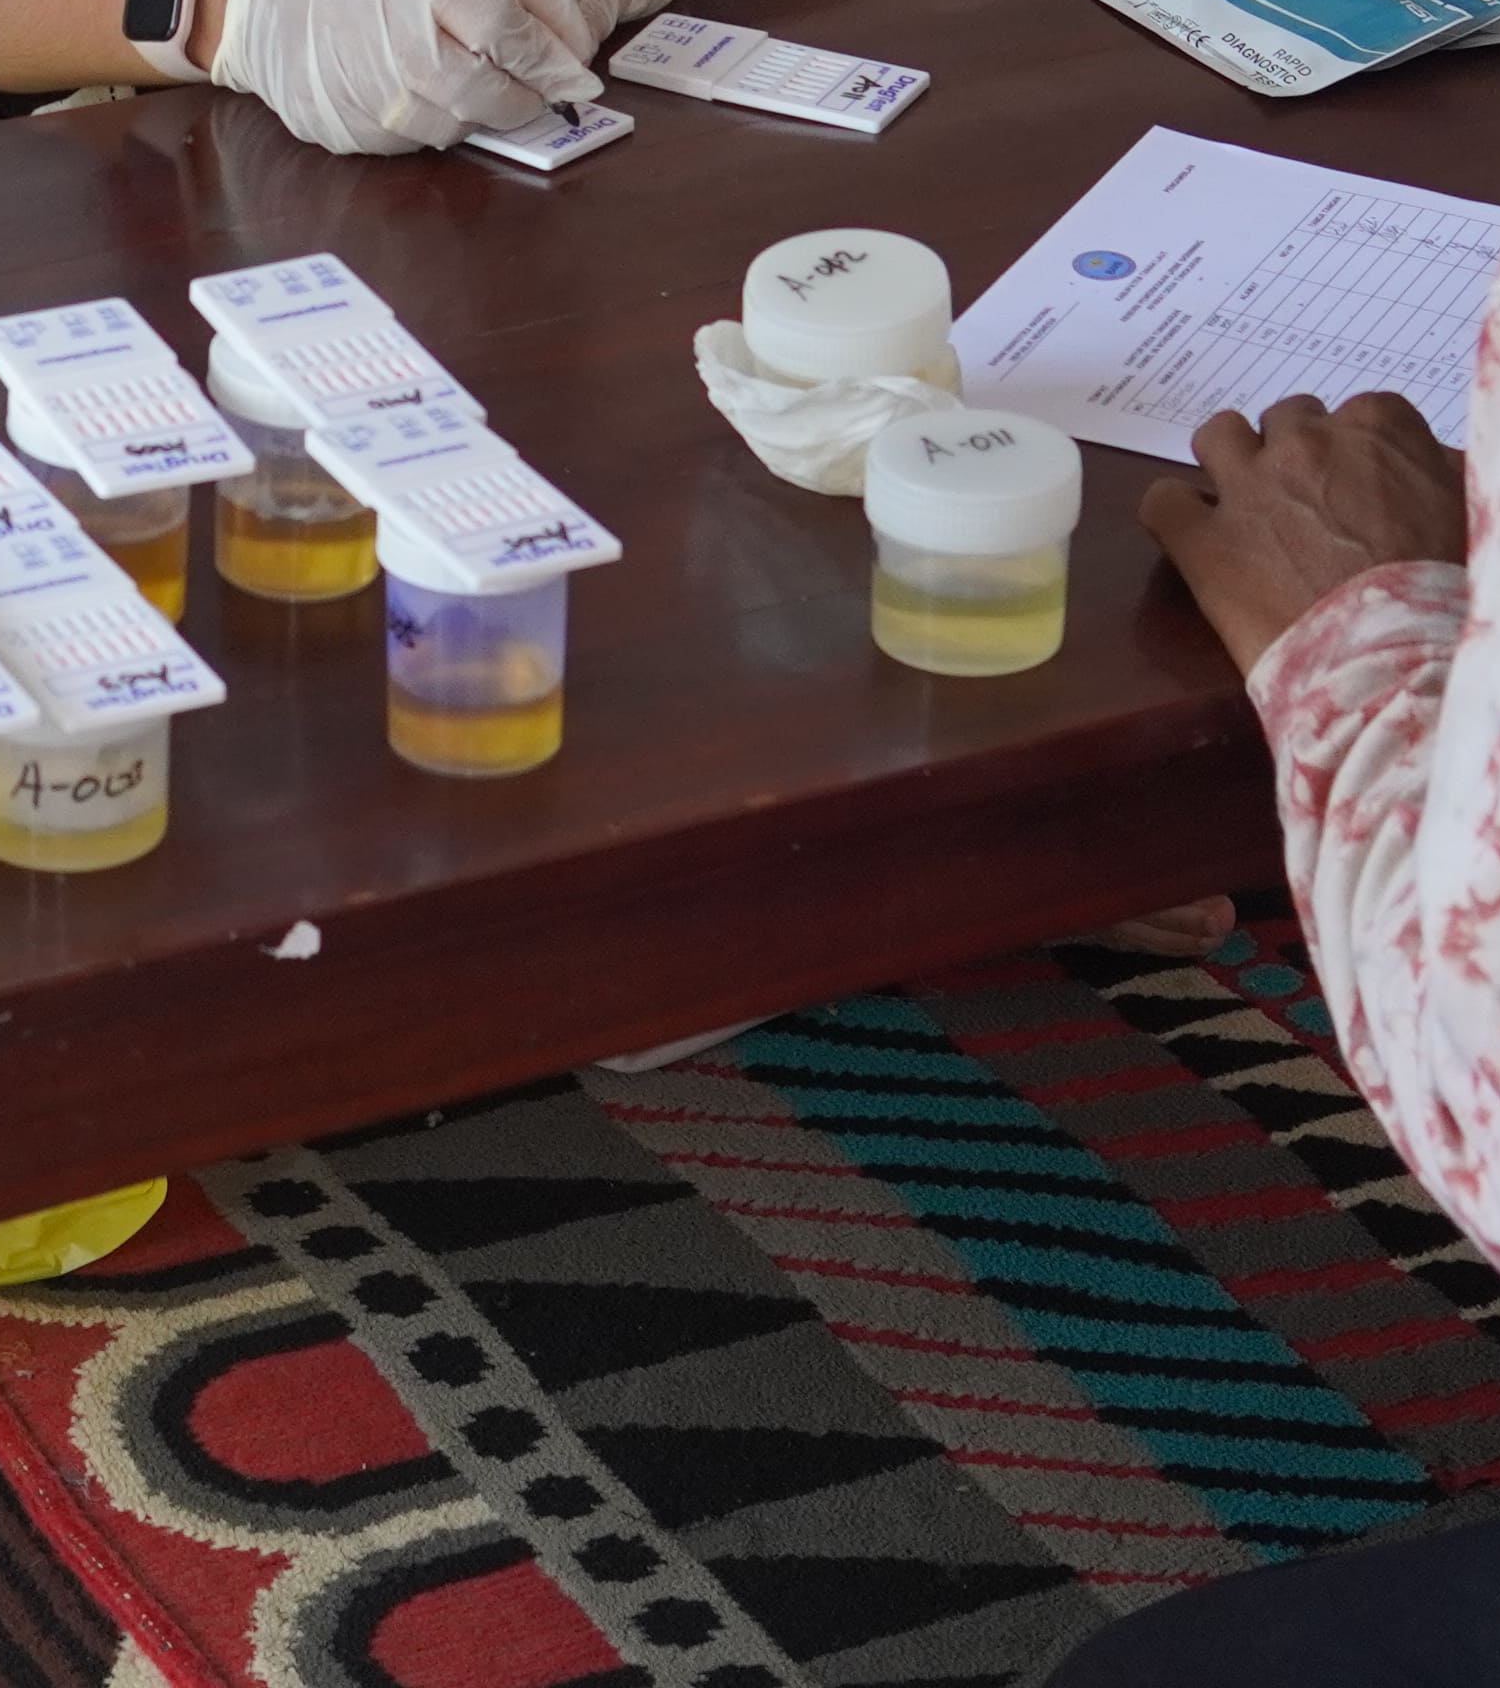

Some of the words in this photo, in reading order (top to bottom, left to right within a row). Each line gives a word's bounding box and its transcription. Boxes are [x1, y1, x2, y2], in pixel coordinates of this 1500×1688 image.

[1221, 32, 1299, 86] DIAGNOSTIC
[1272, 48, 1313, 78] RAPID
[1250, 70, 1283, 89] TEST
[123, 451, 230, 477] DrugTest
